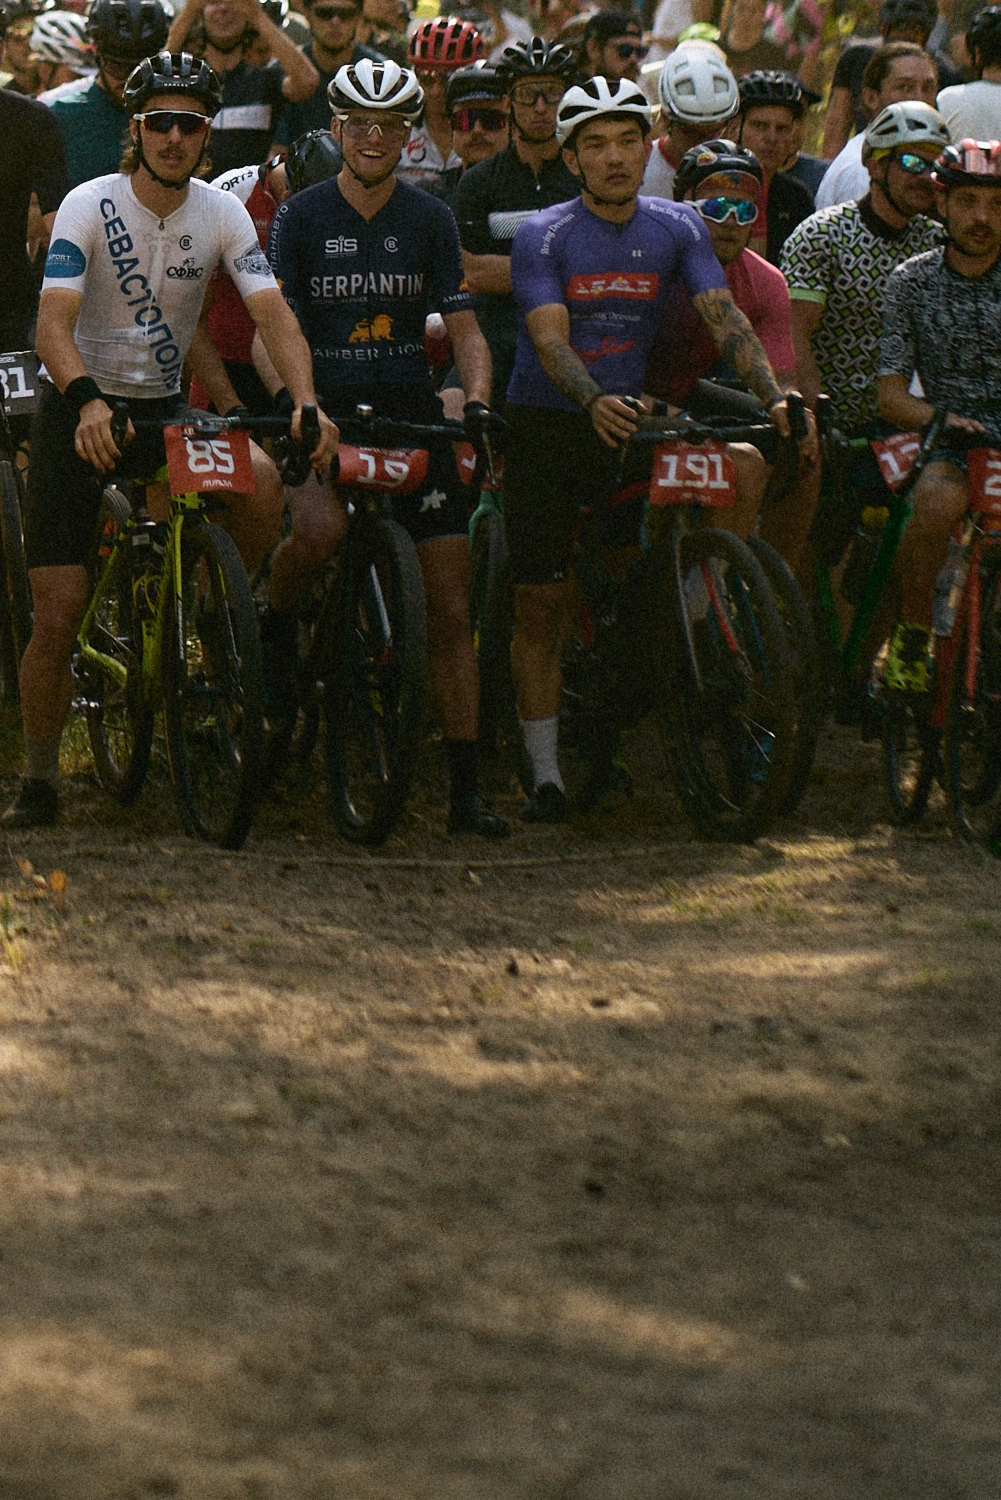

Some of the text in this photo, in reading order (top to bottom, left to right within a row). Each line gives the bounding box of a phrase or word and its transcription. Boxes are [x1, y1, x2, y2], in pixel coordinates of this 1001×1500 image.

[310, 271, 424, 298] SERPANTIN
[185, 439, 235, 475] 85
[658, 453, 730, 489] 191
